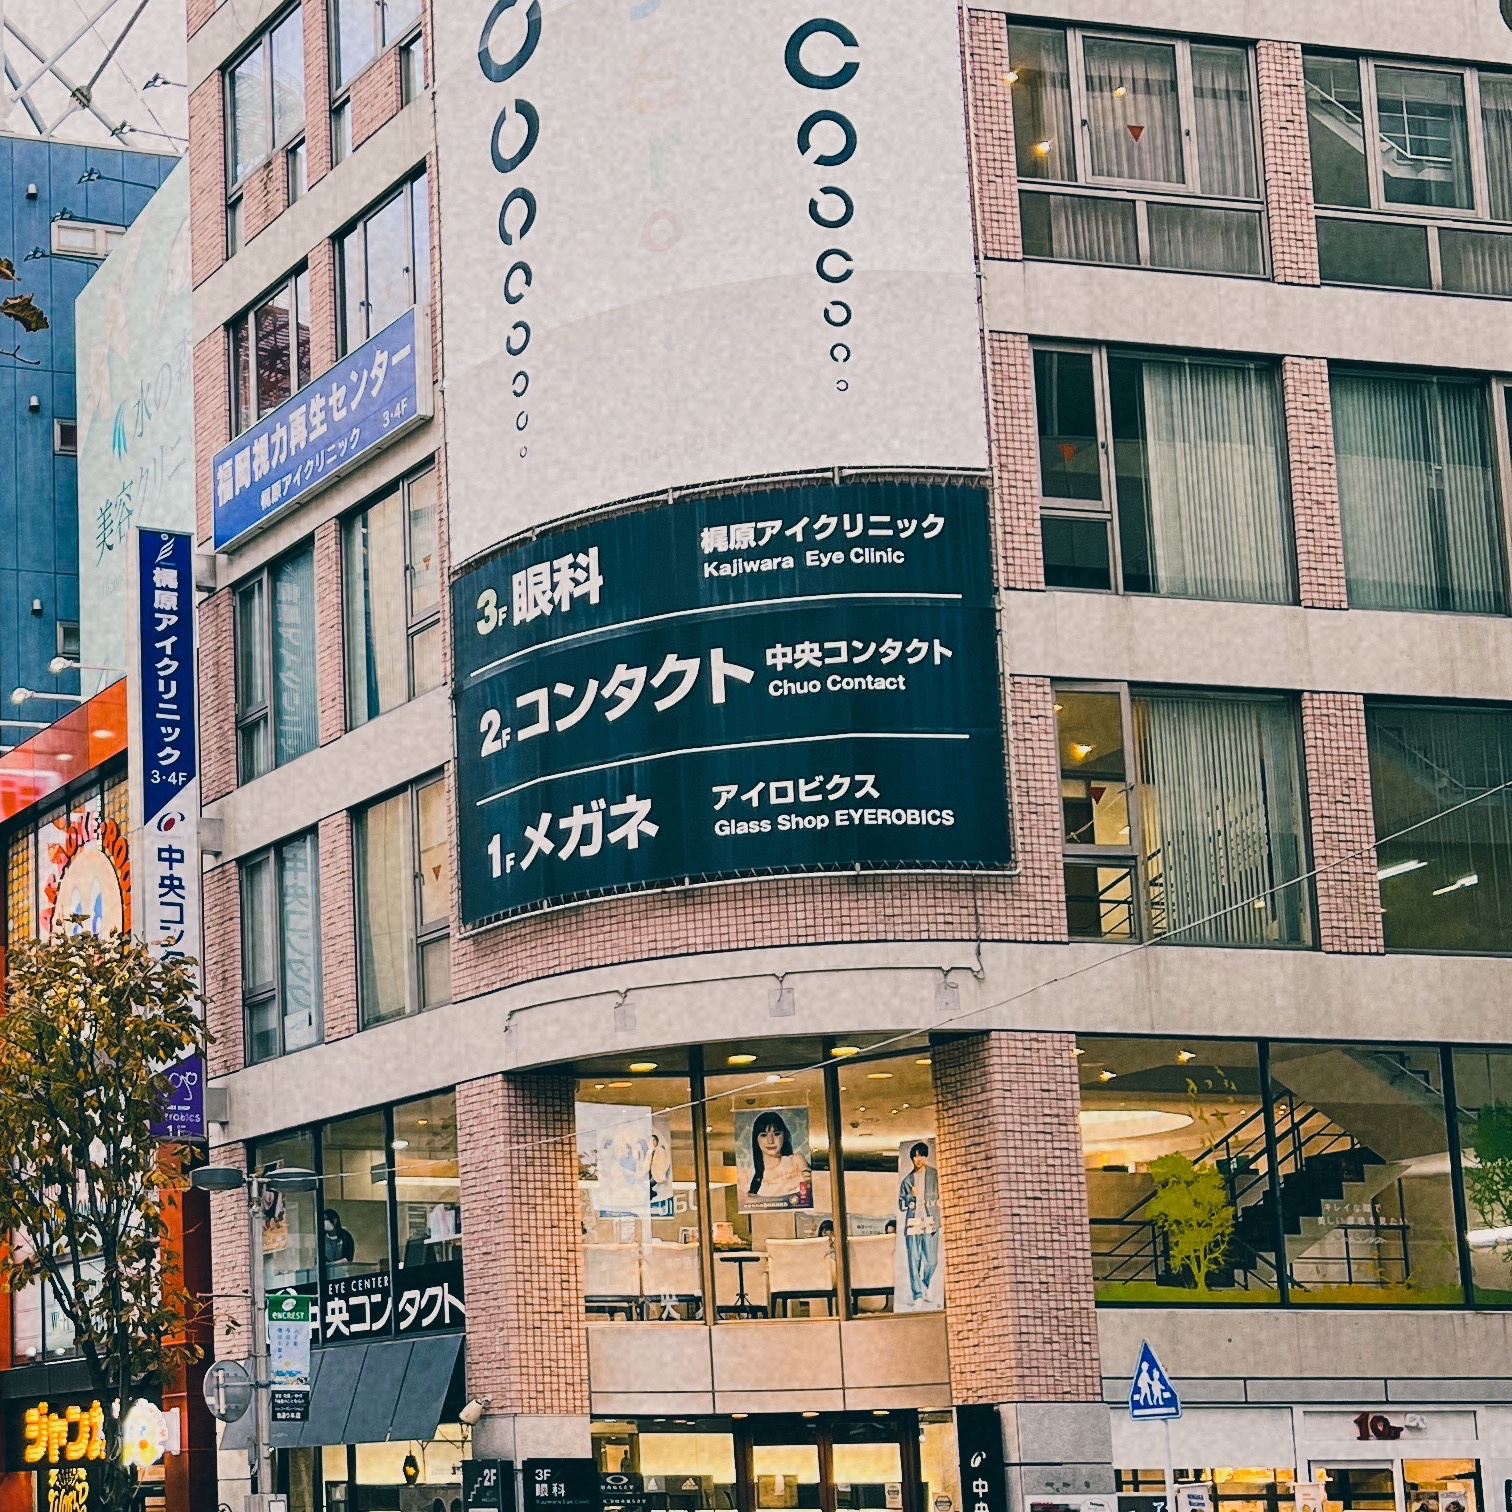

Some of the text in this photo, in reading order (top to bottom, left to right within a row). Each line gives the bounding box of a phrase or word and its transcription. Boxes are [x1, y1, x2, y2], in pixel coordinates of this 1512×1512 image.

[216, 343, 411, 508] 福岡視力再生センター
[700, 513, 945, 554] 梶原アイクリニック
[703, 546, 905, 578] Kajiwara Eye Clinic
[512, 546, 604, 626] 眼科
[153, 567, 181, 766] 梶原アイクリニック
[766, 638, 953, 671] 中央コンタクト
[516, 647, 755, 742] コンタクト
[768, 674, 906, 697] Chuo Contact
[711, 774, 880, 811] アイロビクス
[520, 794, 659, 871] メガネ
[714, 808, 955, 836] Glass Shop EYEROBICS
[328, 1275, 389, 1295] EYE CENTER
[24, 1401, 120, 1464] ジャンカ
[483, 1469, 497, 1487] 2F
[535, 1469, 552, 1481] 3F
[535, 1483, 566, 1497] 眼科
